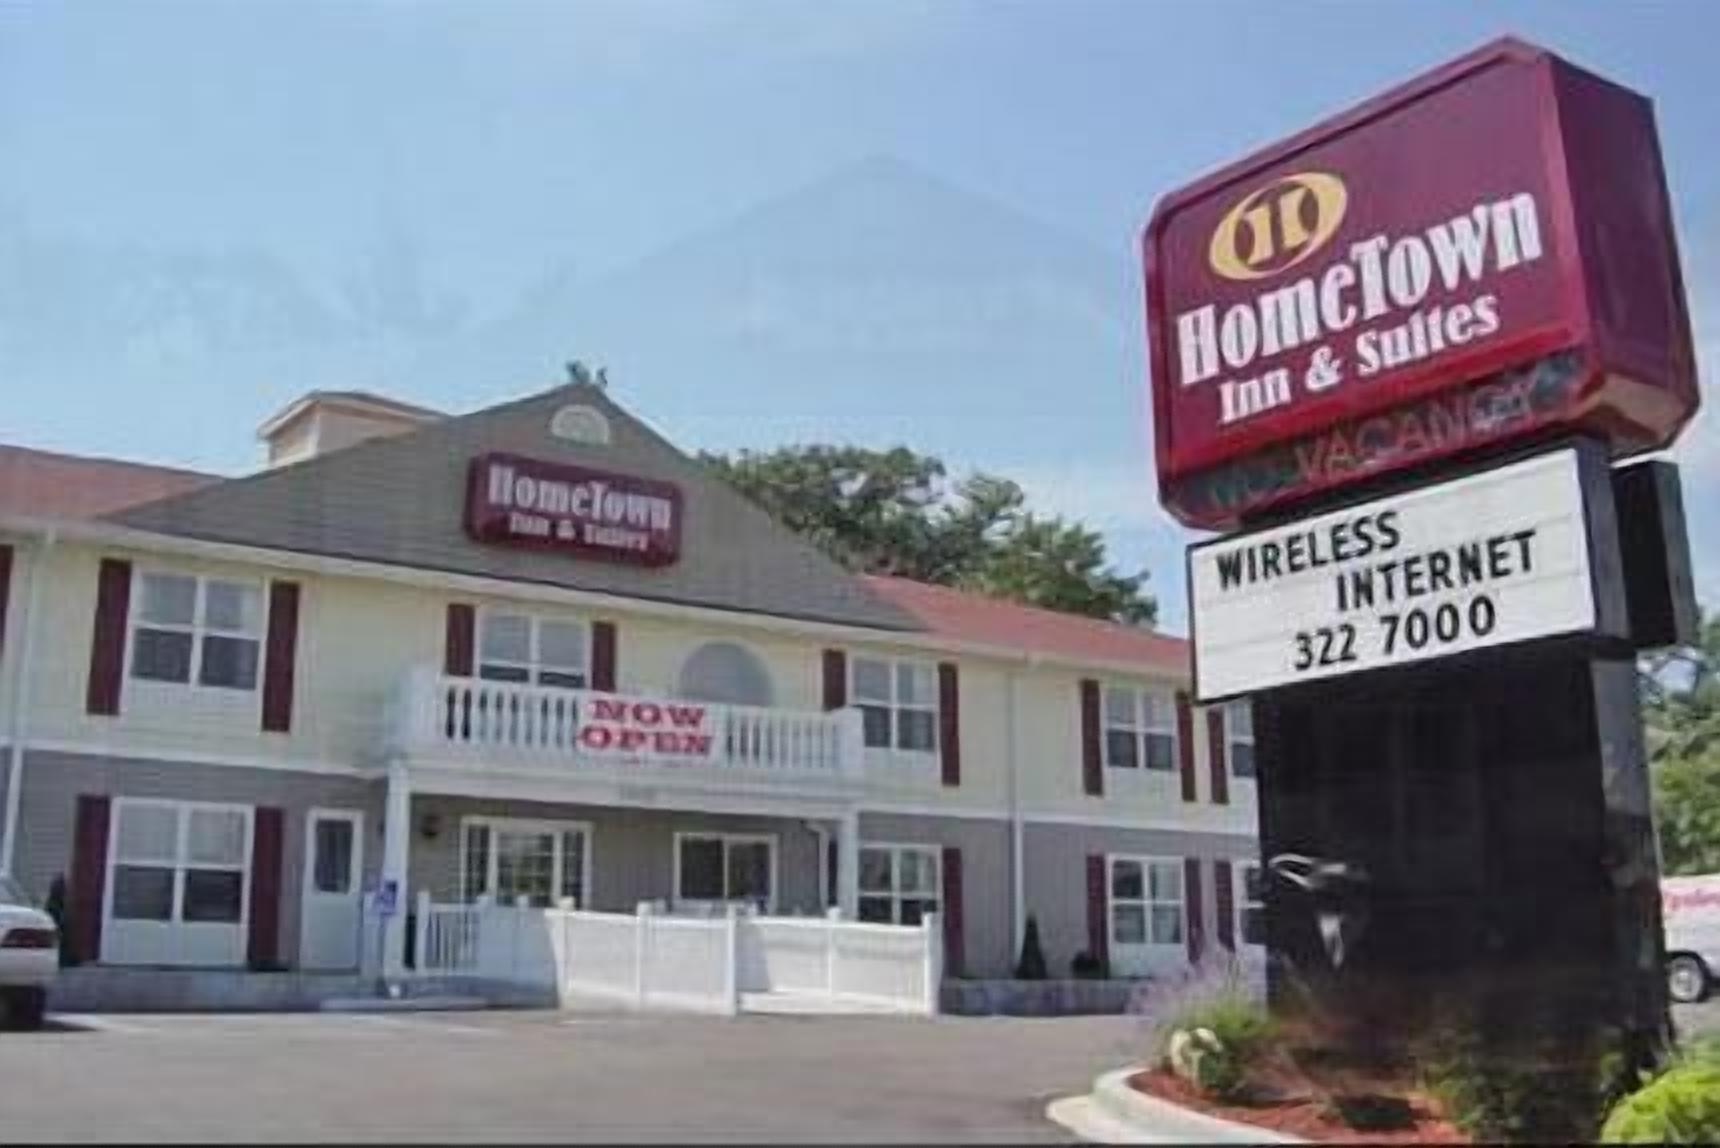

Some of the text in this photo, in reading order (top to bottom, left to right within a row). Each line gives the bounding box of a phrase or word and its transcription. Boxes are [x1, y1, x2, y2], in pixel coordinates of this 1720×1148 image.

[1177, 192, 1542, 386] HomeTown
[1218, 295, 1498, 424] Inn & Suites
[488, 464, 672, 531] HomeTown
[1217, 511, 1400, 590] WIRELESS
[1336, 530, 1536, 611] INTERNET
[1294, 595, 1497, 672] 322 7000
[580, 726, 712, 756] OPEN
[592, 700, 704, 728] NOW
